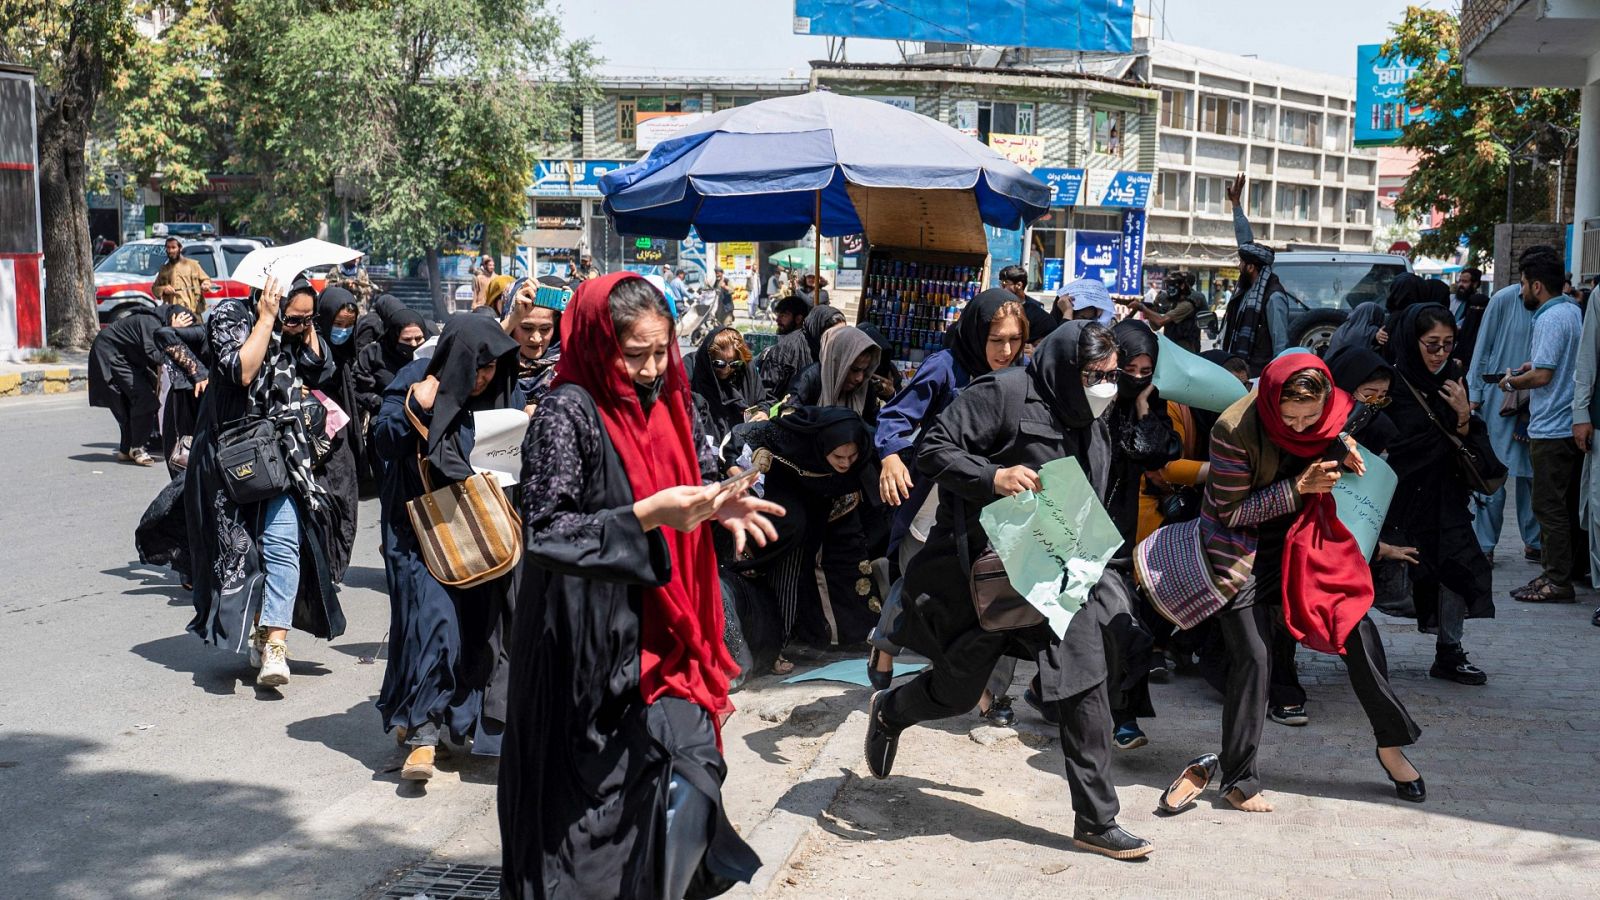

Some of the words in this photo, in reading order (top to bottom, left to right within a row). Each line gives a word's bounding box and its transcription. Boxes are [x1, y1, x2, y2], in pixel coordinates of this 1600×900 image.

[549, 161, 586, 174] Idal
[1081, 244, 1112, 265] نقشه
[235, 461, 254, 477] CAT
